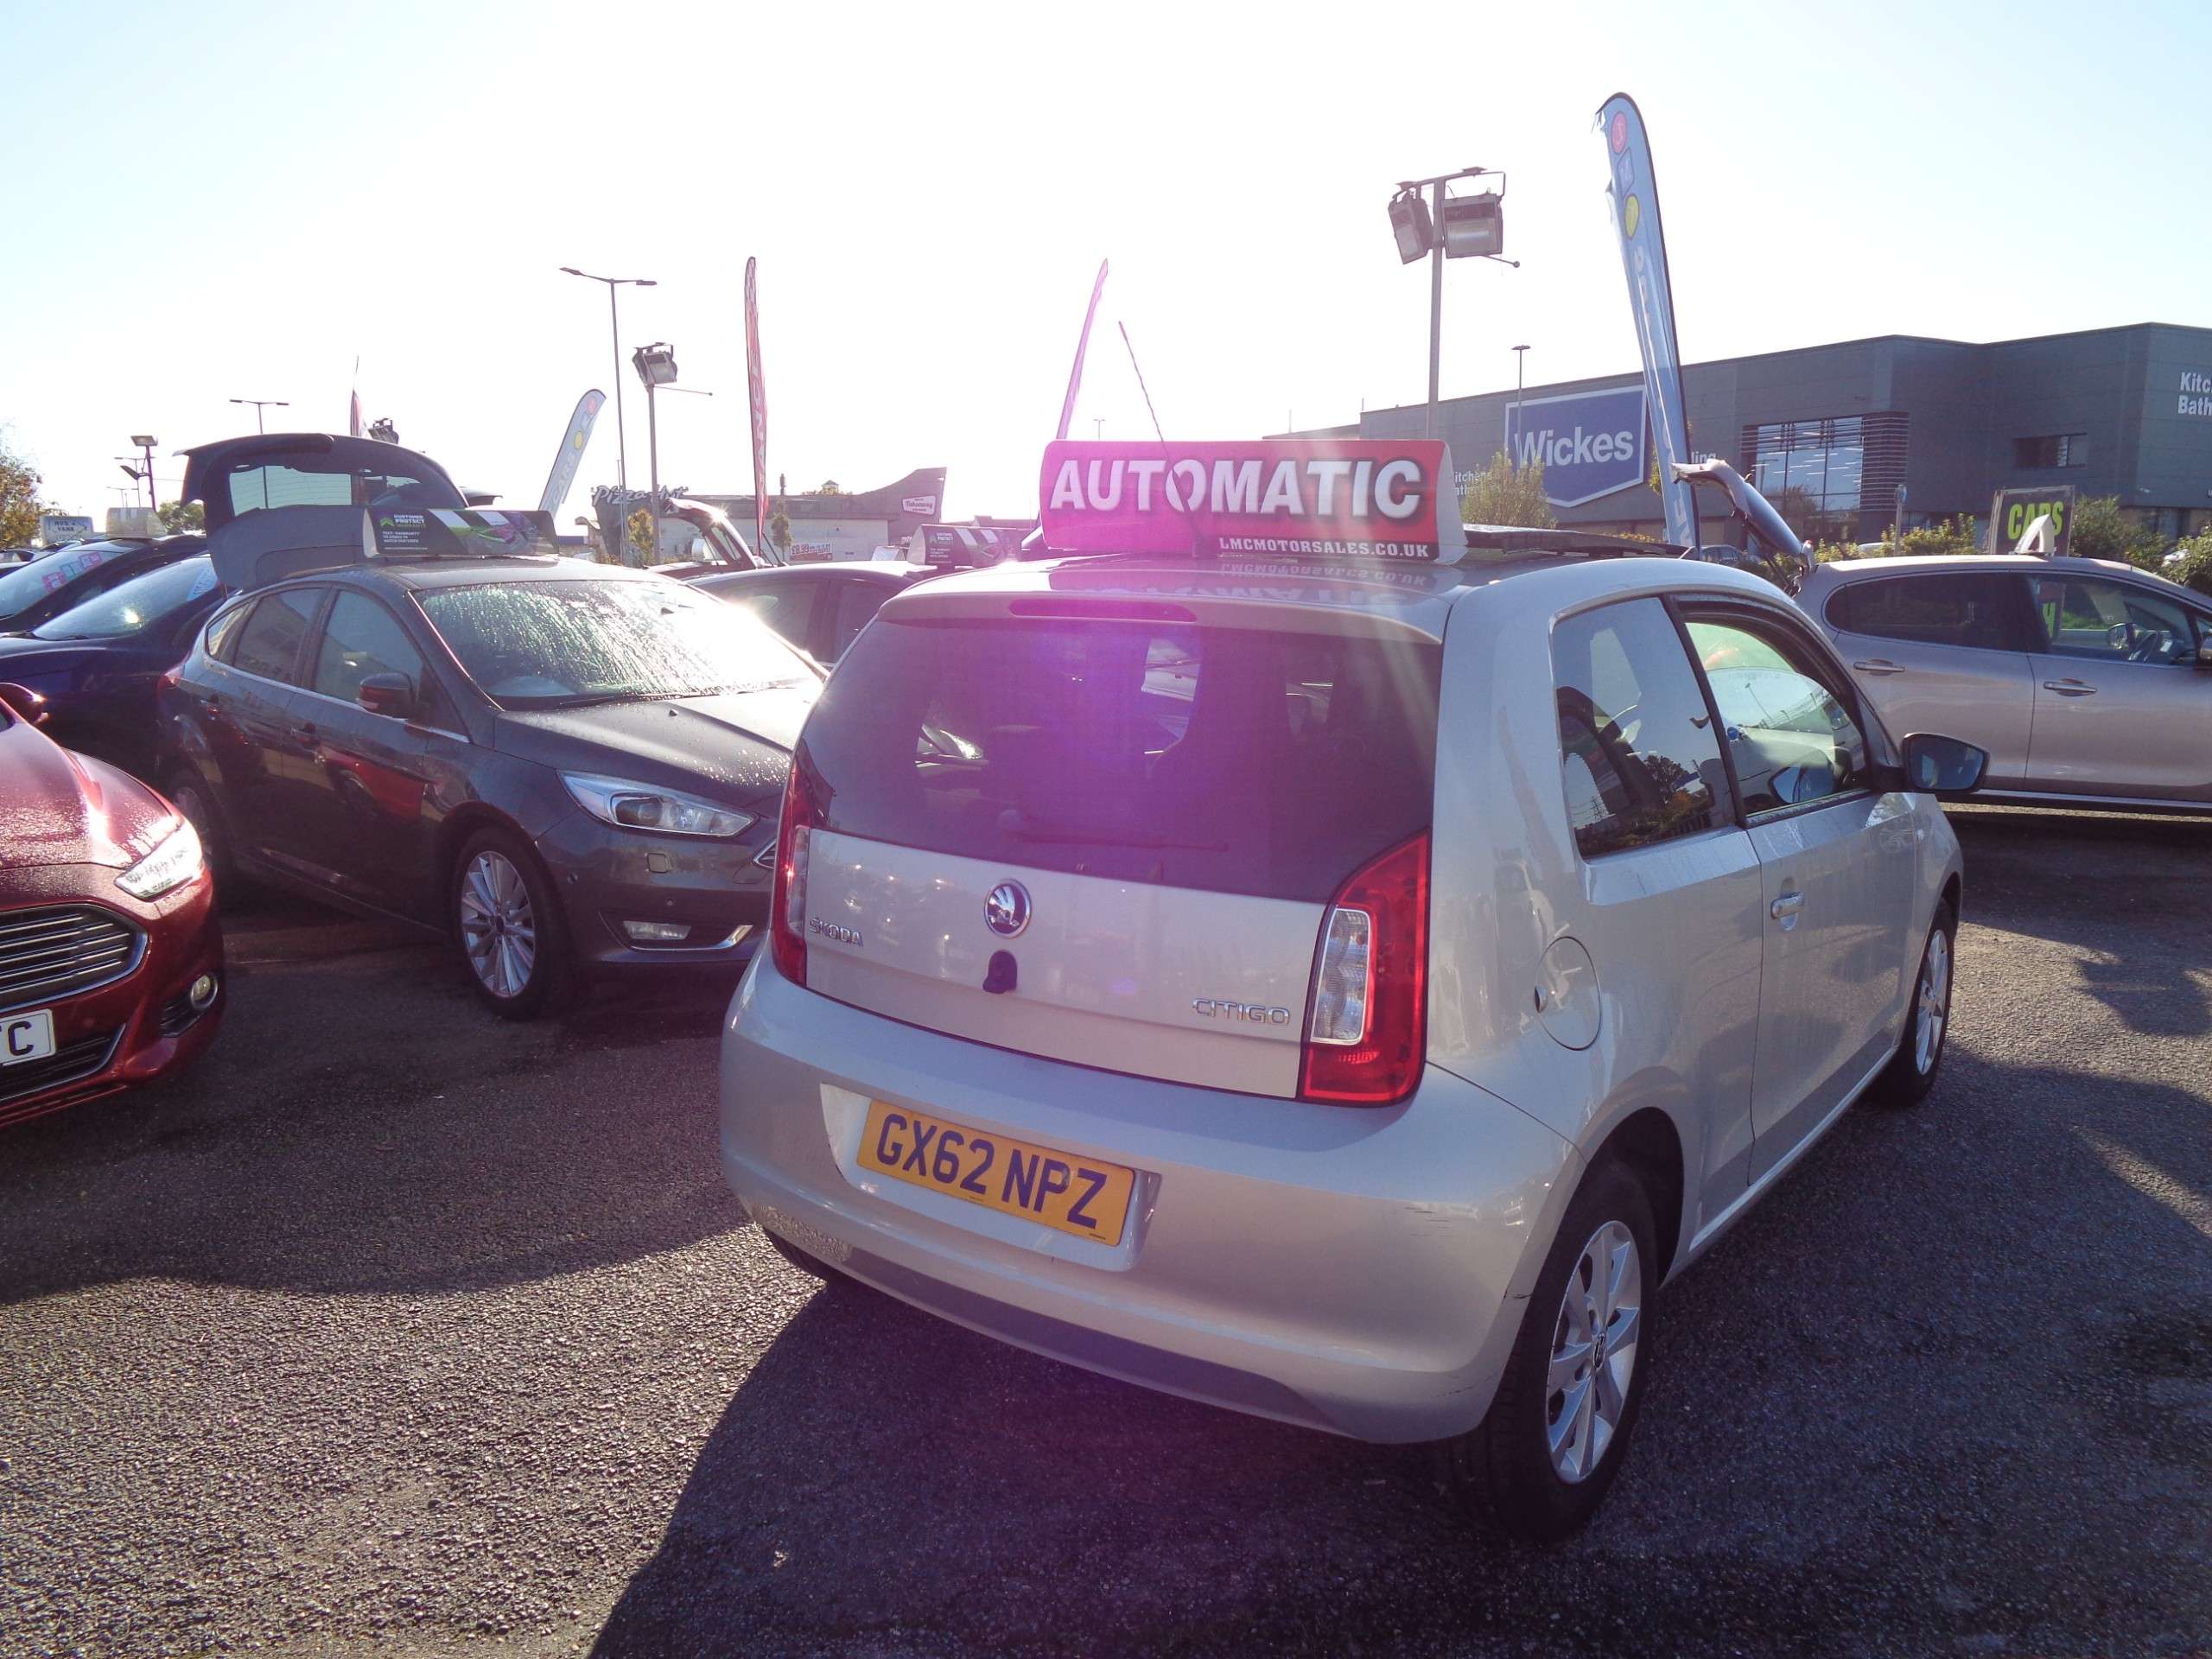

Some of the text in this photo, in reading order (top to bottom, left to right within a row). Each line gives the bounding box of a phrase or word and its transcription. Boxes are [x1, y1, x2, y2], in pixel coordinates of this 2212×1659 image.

[2180, 372, 2212, 392] Kitc
[1514, 426, 1634, 468] Wickes
[592, 485, 647, 506] Pizza
[1049, 459, 1421, 518] AUTOMATIC
[1219, 537, 1429, 557] LMCMOTORSALES.CO.UK
[1191, 998, 1290, 1025] CITIGO
[876, 1113, 1108, 1230] GX62 NPZ
